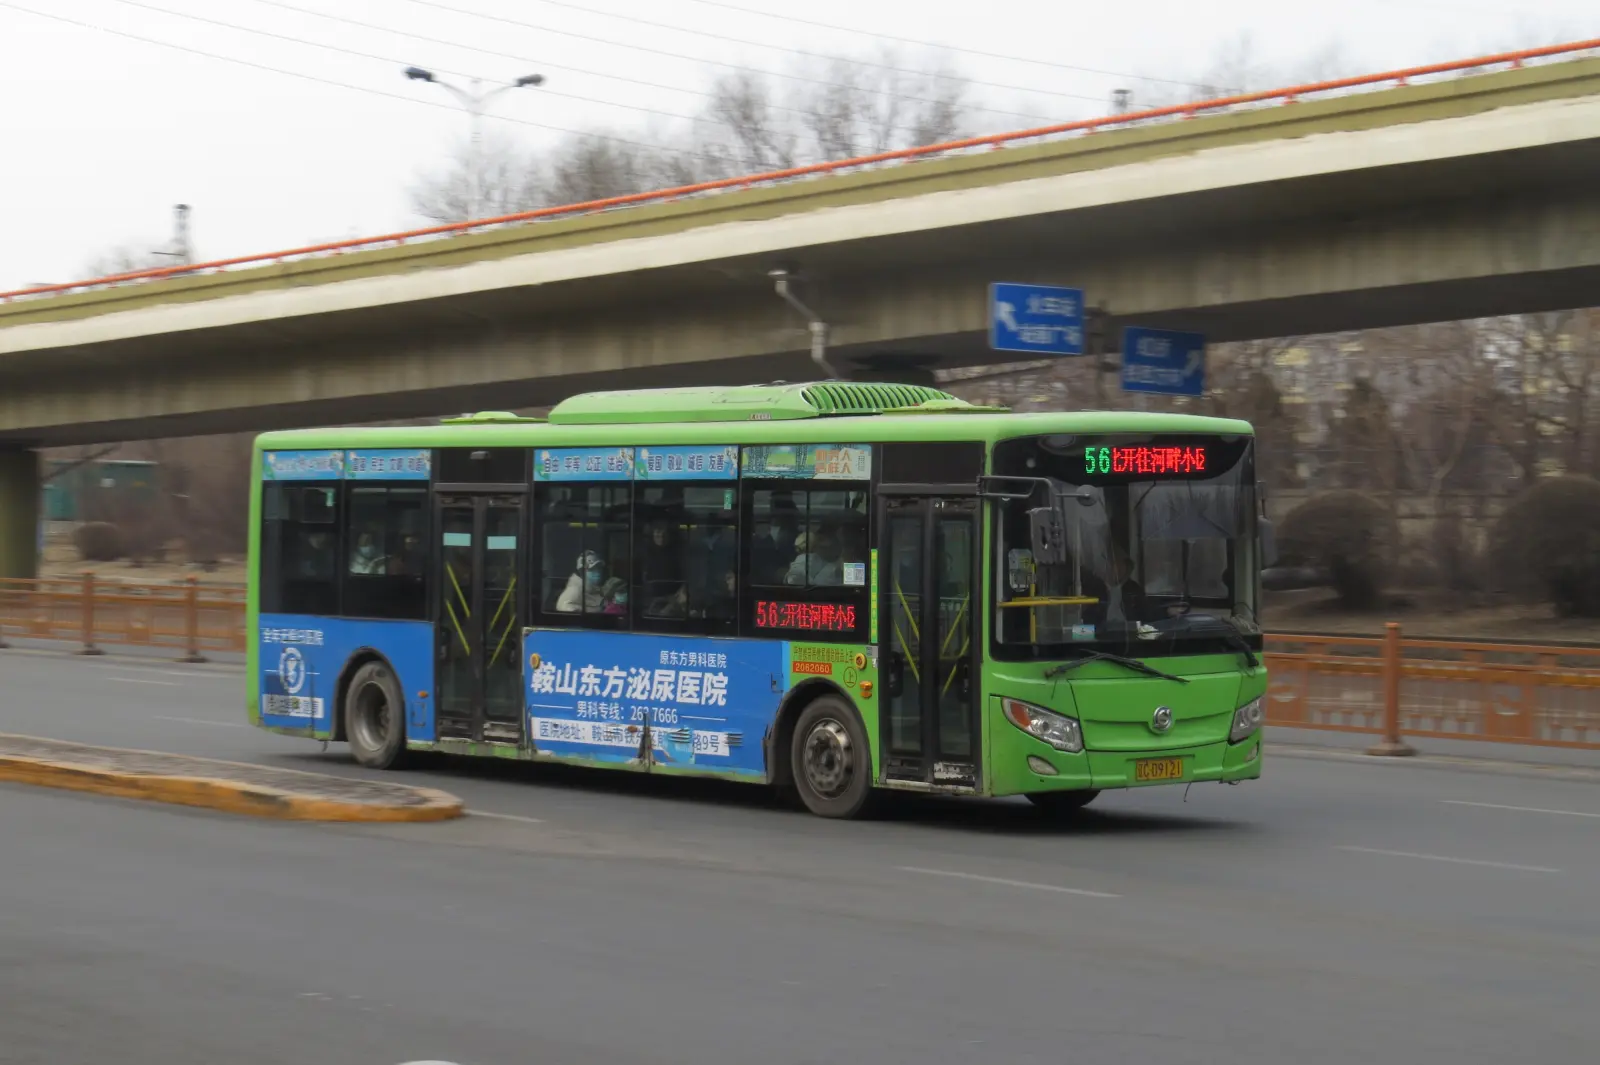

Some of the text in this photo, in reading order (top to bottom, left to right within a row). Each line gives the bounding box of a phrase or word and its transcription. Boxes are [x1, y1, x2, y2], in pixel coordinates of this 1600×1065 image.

[1085, 447, 1110, 474] 56
[756, 601, 778, 628] 56
[660, 650, 727, 669] 原东方男科医院
[530, 661, 729, 706] 鞍山东方泌尿医院
